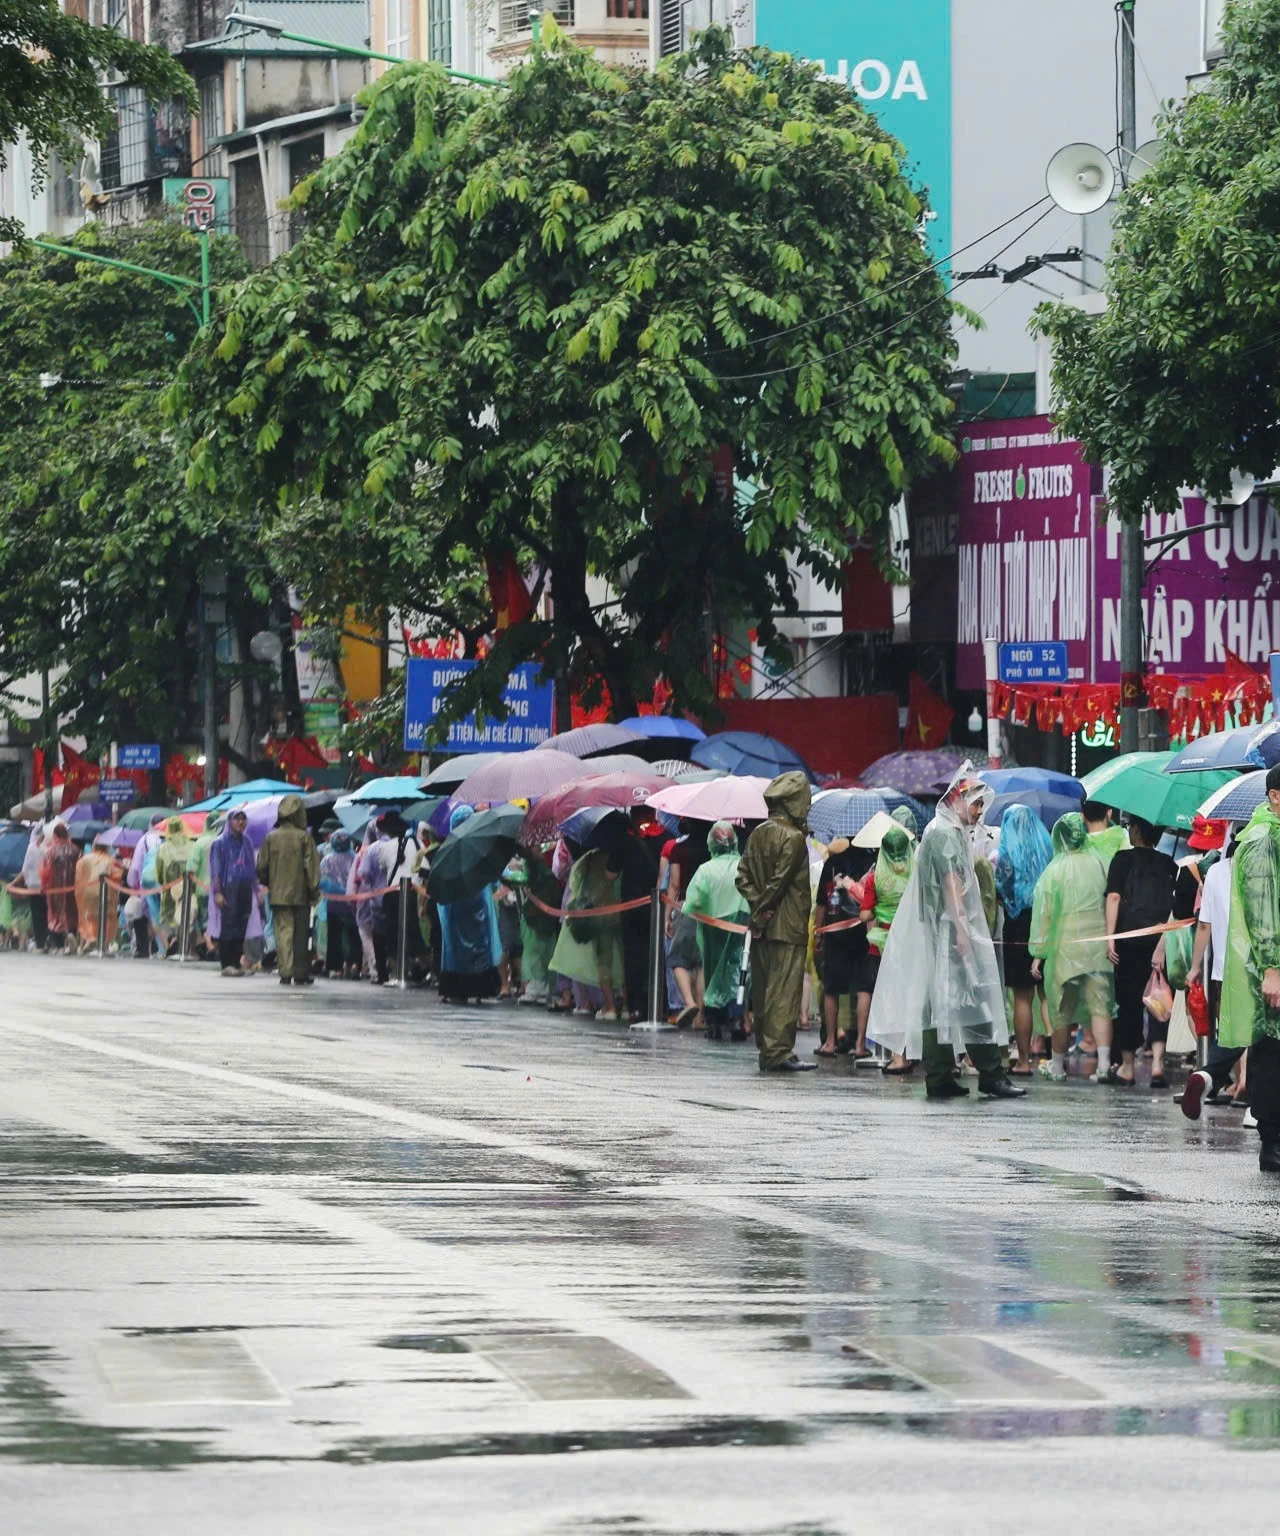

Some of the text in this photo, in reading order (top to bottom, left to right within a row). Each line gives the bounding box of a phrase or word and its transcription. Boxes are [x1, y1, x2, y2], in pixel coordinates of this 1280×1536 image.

[802, 59, 929, 100] HOA
[973, 464, 1073, 503] FRESH FRUITS
[957, 543, 979, 645] HOA
[1011, 647, 1056, 662] NGÕ 52
[507, 671, 528, 690] MÃ
[1006, 663, 1022, 678] PHỐ
[1027, 667, 1043, 677] KIM
[408, 721, 424, 740] CÁC
[456, 722, 473, 744] TIỆN
